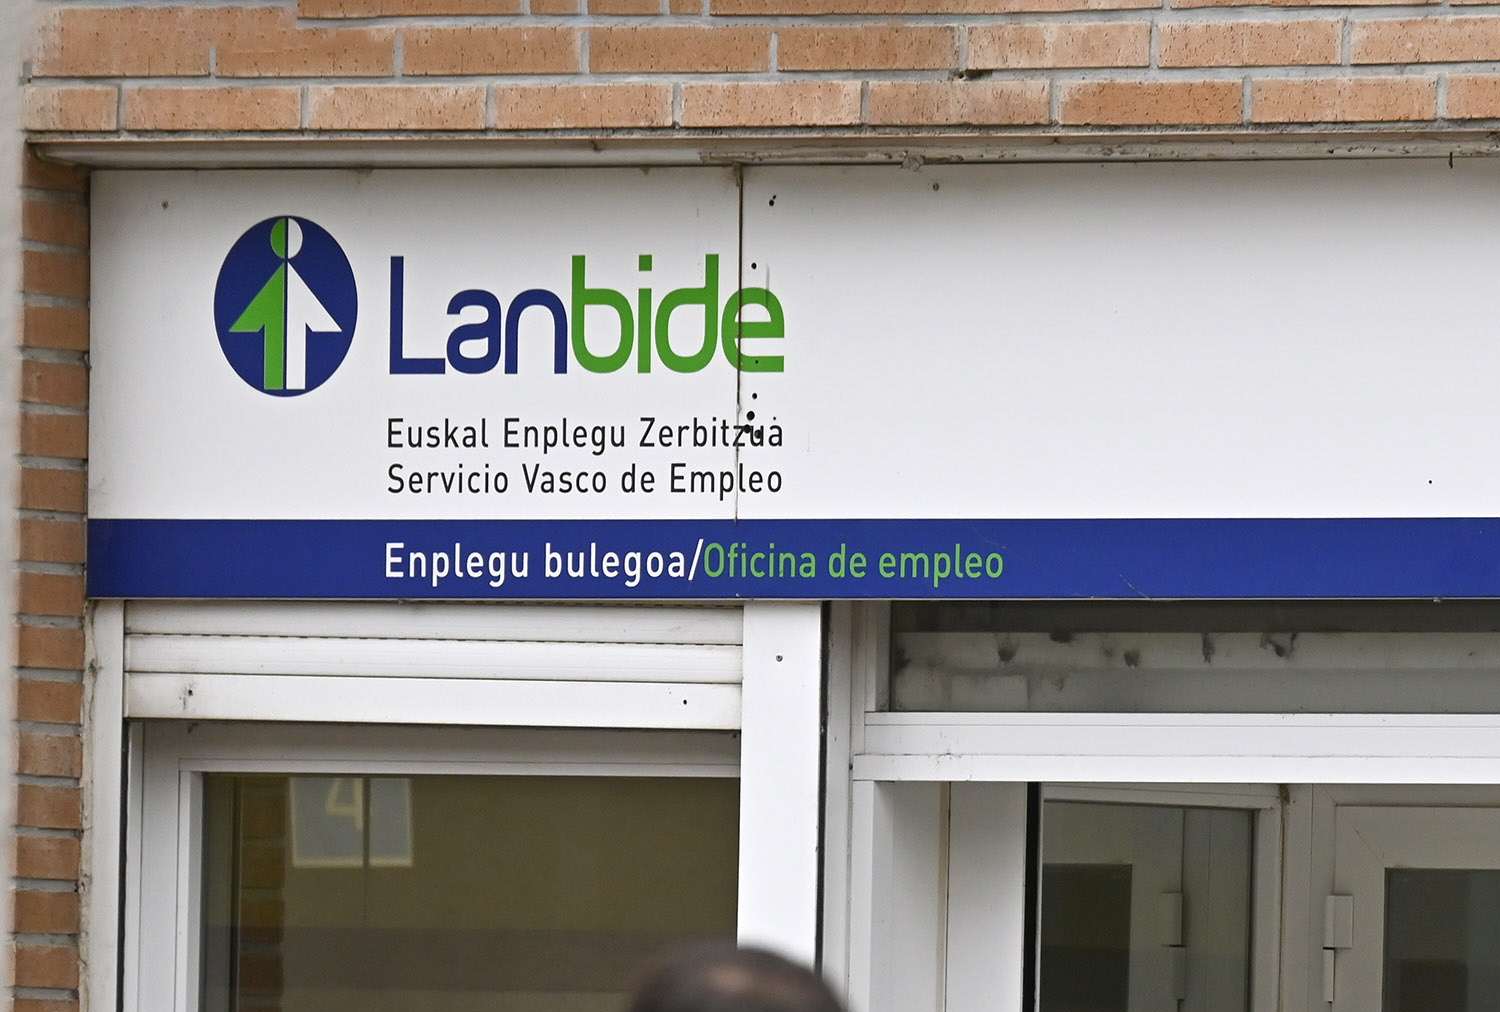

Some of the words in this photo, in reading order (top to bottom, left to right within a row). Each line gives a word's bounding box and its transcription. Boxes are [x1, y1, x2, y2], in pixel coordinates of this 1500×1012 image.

[389, 254, 785, 374] Lanbide
[387, 417, 489, 448] Euskal
[503, 417, 626, 456] Enplegu
[639, 416, 784, 448] Zerbitzua
[387, 463, 509, 494] Servicio
[522, 463, 607, 494] Vasco
[621, 462, 655, 494] de
[670, 462, 783, 501] Empleo
[384, 543, 529, 587] Enplegu
[828, 544, 867, 579] de
[879, 544, 1004, 587] empleo
